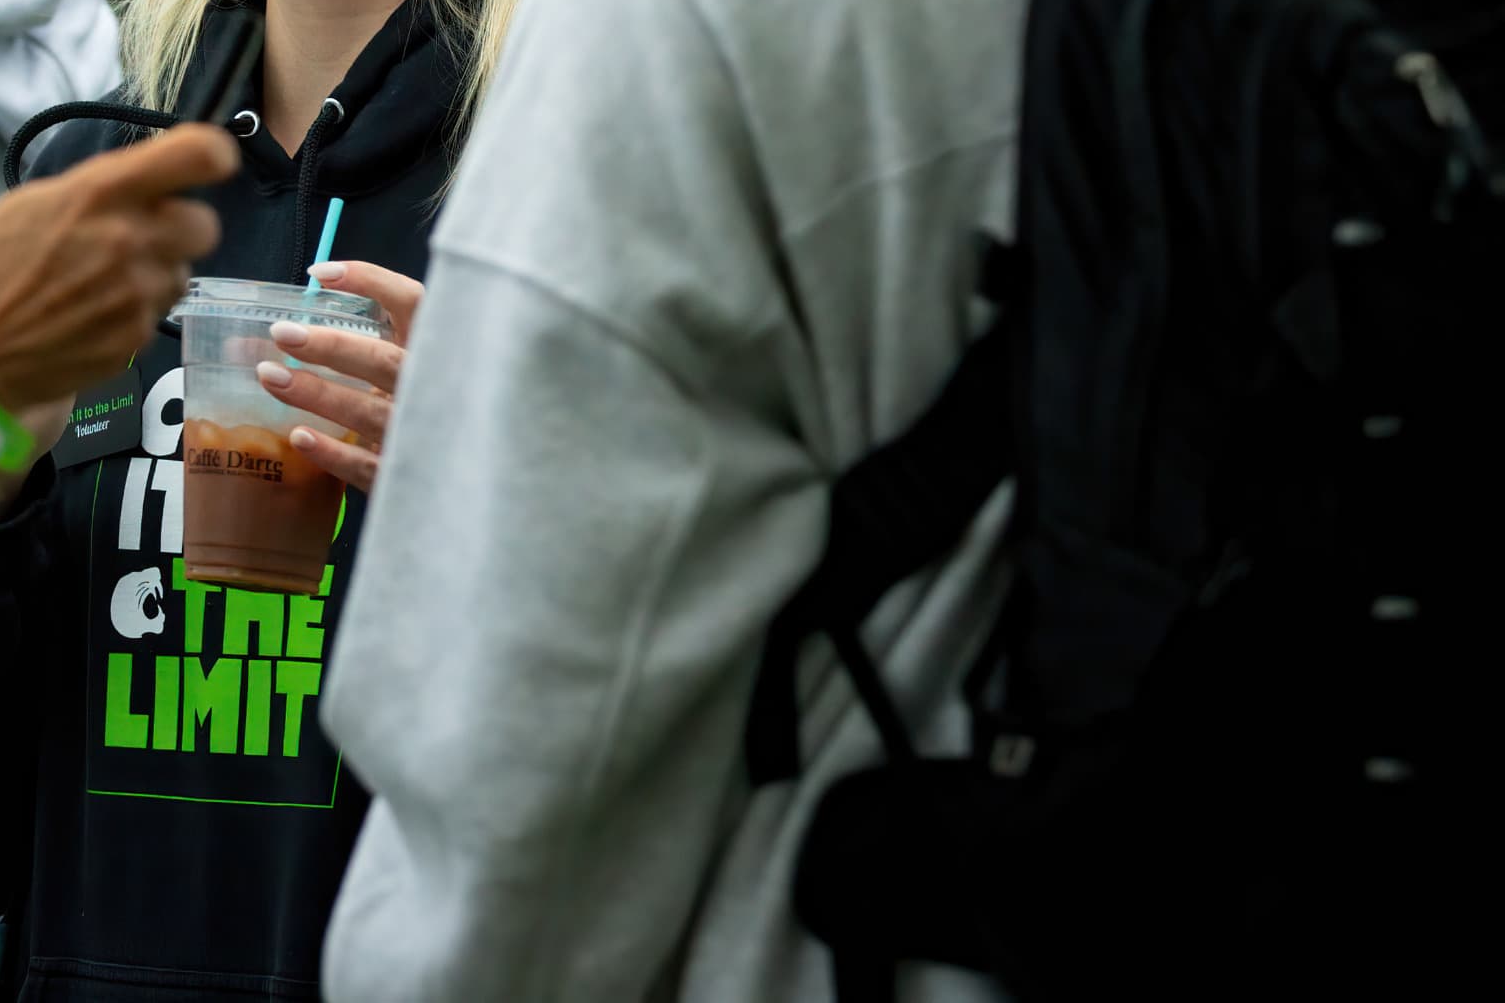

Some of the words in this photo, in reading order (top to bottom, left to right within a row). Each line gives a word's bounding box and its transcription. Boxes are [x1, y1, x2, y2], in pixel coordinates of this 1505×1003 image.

[75, 419, 110, 438] Volunteer
[76, 408, 83, 421] it
[84, 406, 93, 419] to
[95, 401, 109, 415] the
[111, 392, 134, 411] Limit
[172, 557, 335, 659] THE
[104, 652, 323, 757] LIMIT
